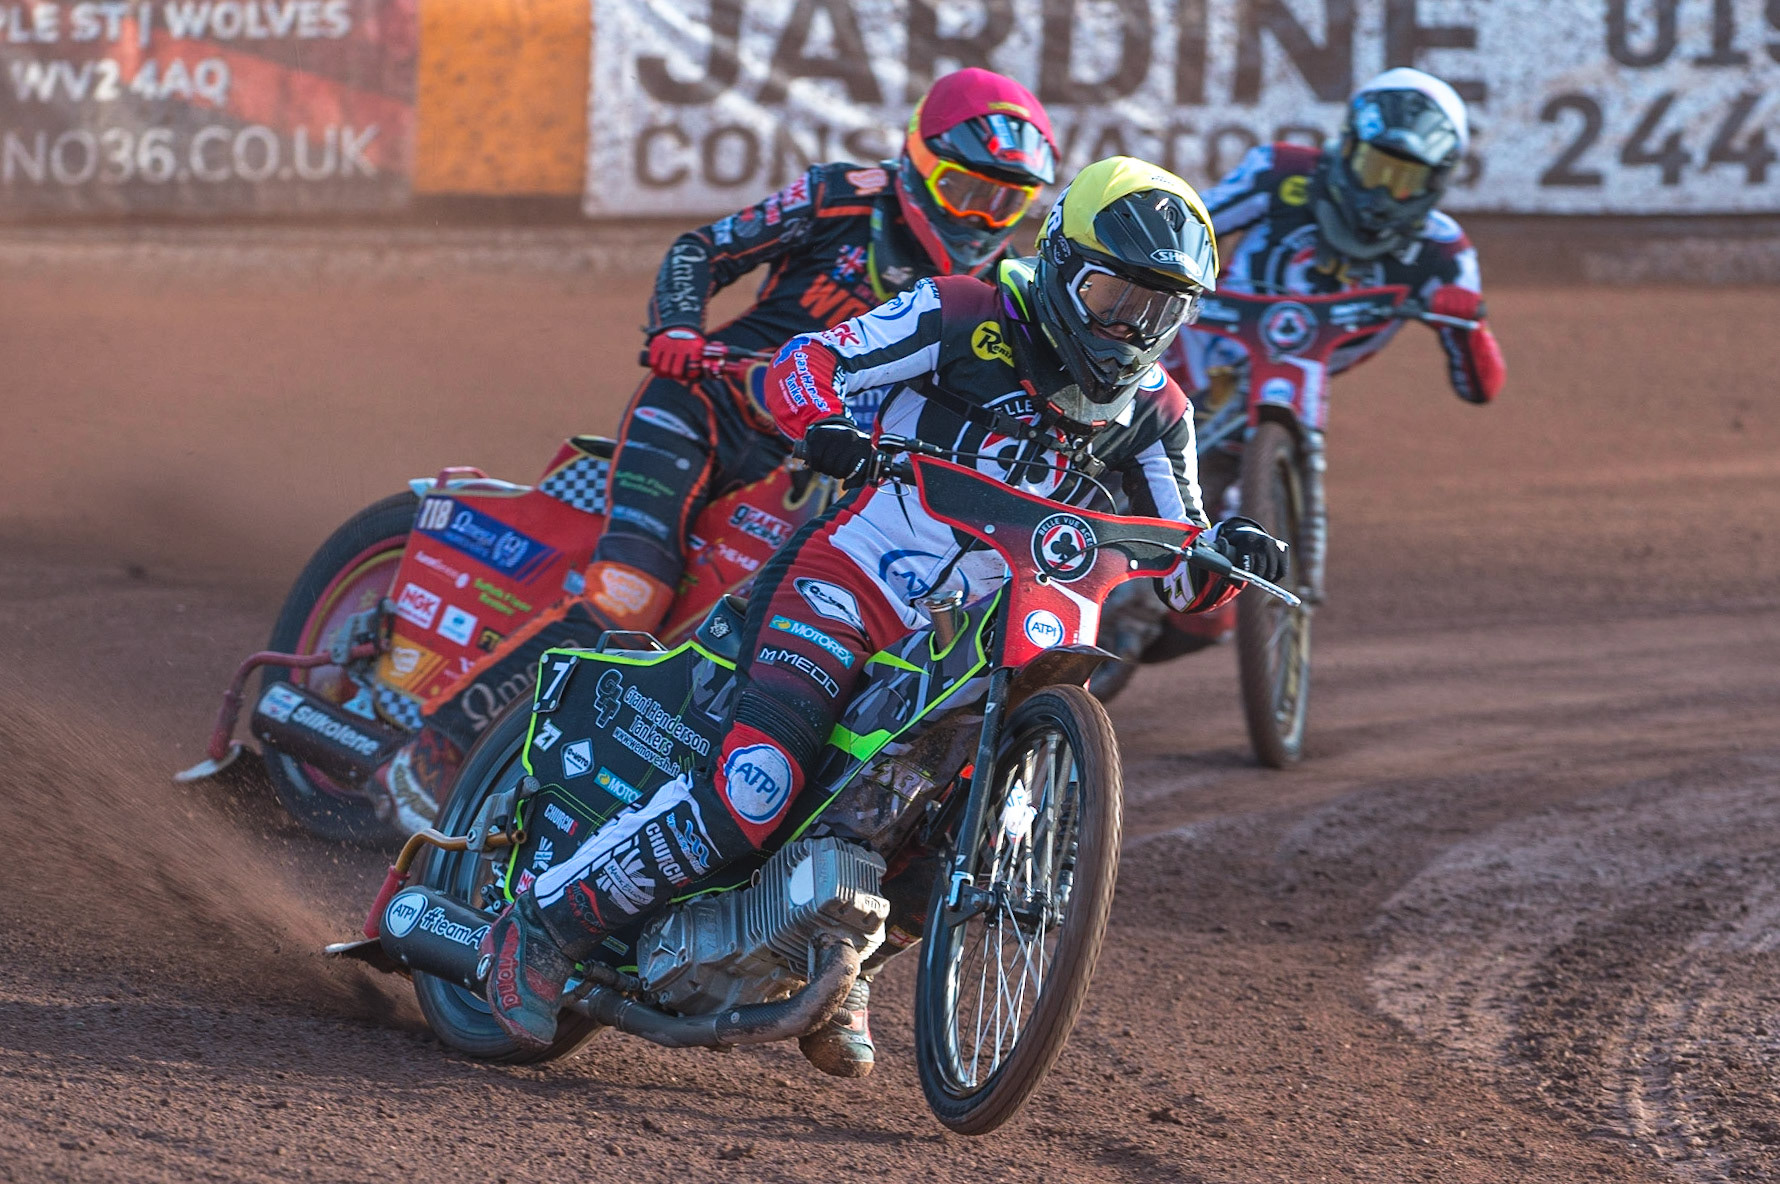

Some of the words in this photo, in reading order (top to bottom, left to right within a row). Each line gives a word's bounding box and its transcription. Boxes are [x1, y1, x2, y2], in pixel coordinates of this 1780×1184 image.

[70, 1, 126, 43] ST
[164, 0, 353, 40] WOLVES
[130, 57, 231, 104] 4AQ
[1537, 92, 1779, 187] 244
[1038, 517, 1060, 537] BELLE
[1062, 516, 1080, 529] VUE
[790, 622, 852, 666] MOTOREX
[1031, 621, 1058, 637] ATPI
[541, 661, 571, 700] 7
[628, 714, 674, 757] Tankers
[649, 697, 711, 757] Henderson
[607, 777, 642, 803] MOTO
[735, 762, 781, 805] ATPI
[392, 903, 418, 921] ATPI
[420, 907, 491, 950] #teamA
